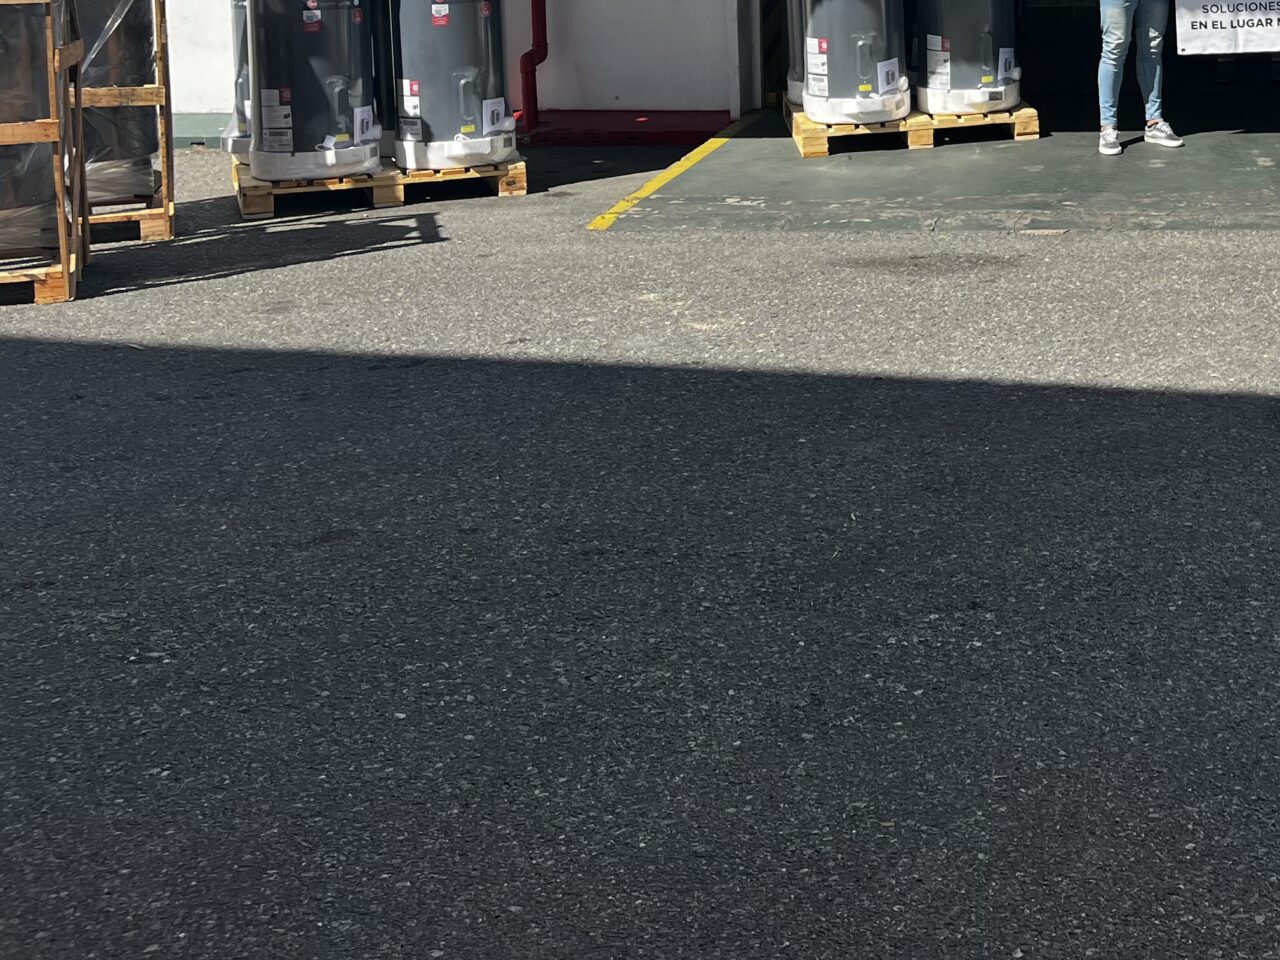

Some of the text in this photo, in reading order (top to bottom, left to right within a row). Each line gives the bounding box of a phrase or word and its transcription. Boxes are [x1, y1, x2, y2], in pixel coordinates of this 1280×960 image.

[1191, 21, 1208, 30] EN
[1212, 20, 1227, 29] EL
[1230, 18, 1273, 29] LUGAR
